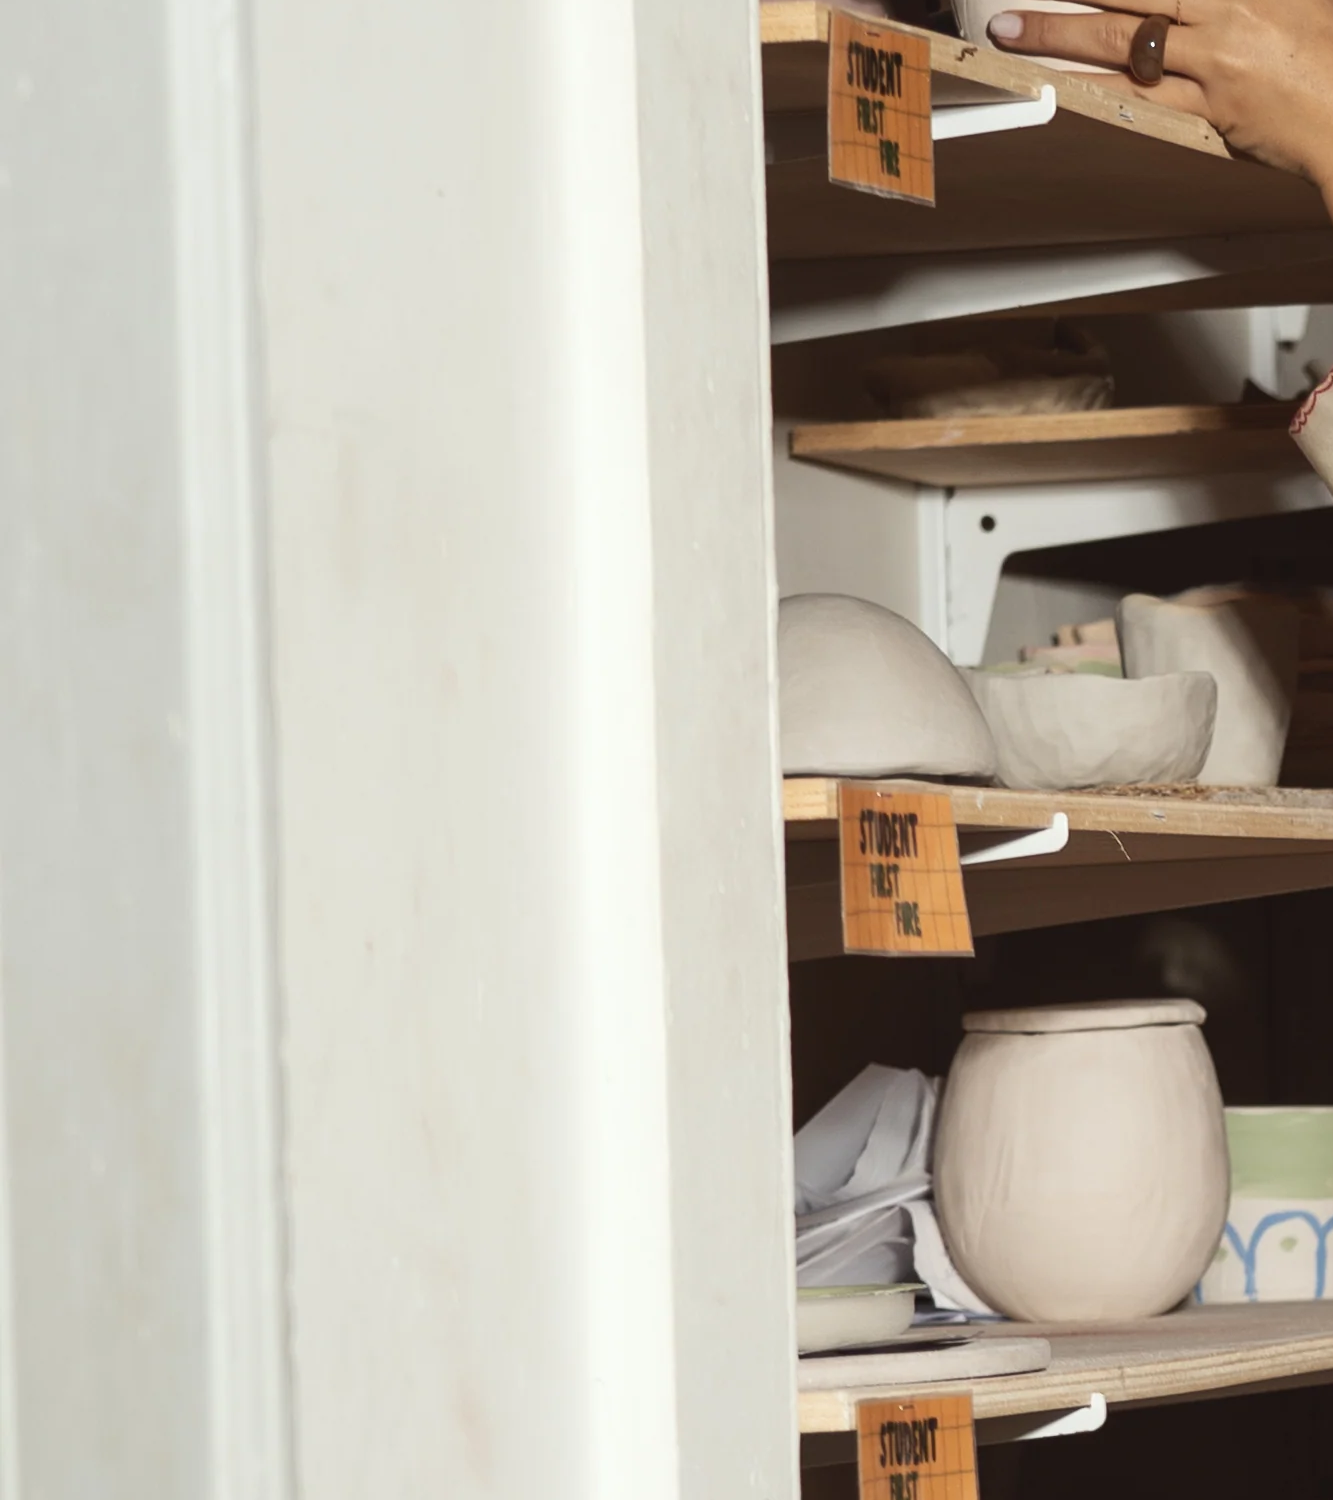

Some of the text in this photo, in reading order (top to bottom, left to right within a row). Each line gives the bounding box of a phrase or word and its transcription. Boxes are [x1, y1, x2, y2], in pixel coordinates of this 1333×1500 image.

[846, 41, 903, 99] STUDENT
[859, 808, 919, 859] STUDENT
[879, 1417, 939, 1469] STUDENT
